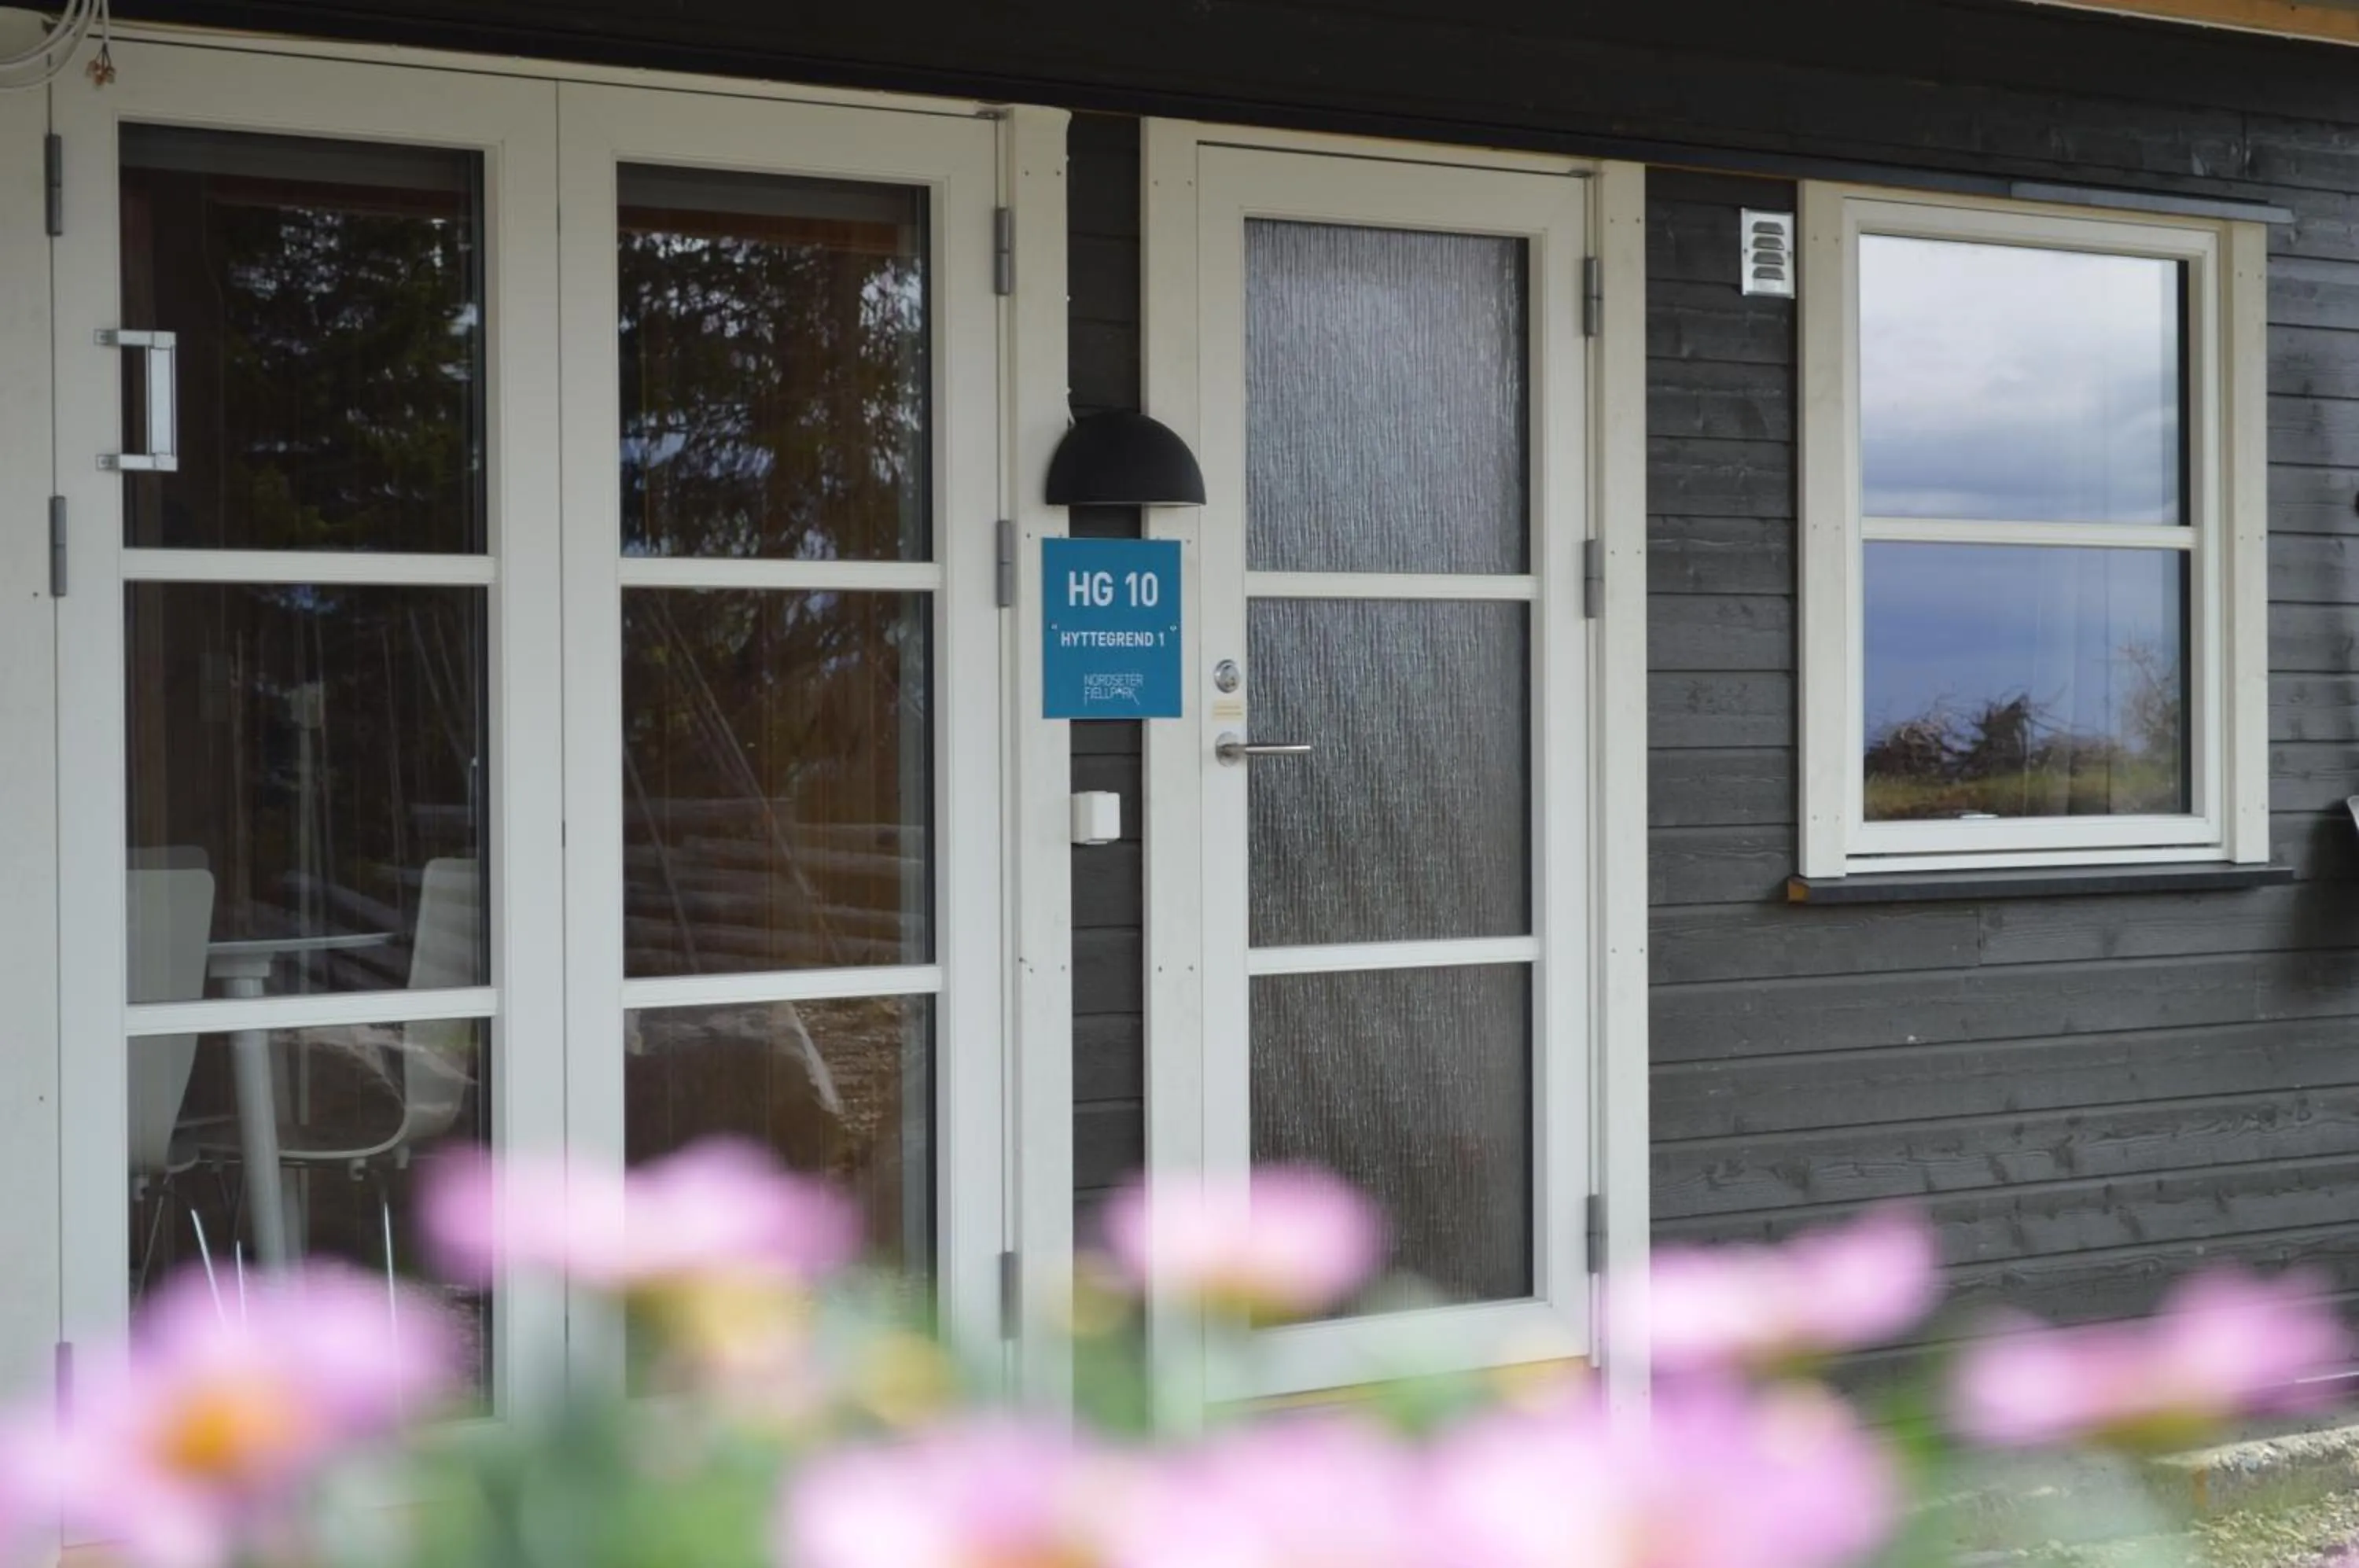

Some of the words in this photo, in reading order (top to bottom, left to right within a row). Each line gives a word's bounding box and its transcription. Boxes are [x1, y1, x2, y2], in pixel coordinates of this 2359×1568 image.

[1069, 571, 1113, 606] HG
[1125, 572, 1158, 607] 10
[1062, 631, 1154, 647] HYTTEGREND
[1159, 631, 1165, 646] 1
[1084, 673, 1143, 686] NORDSETER
